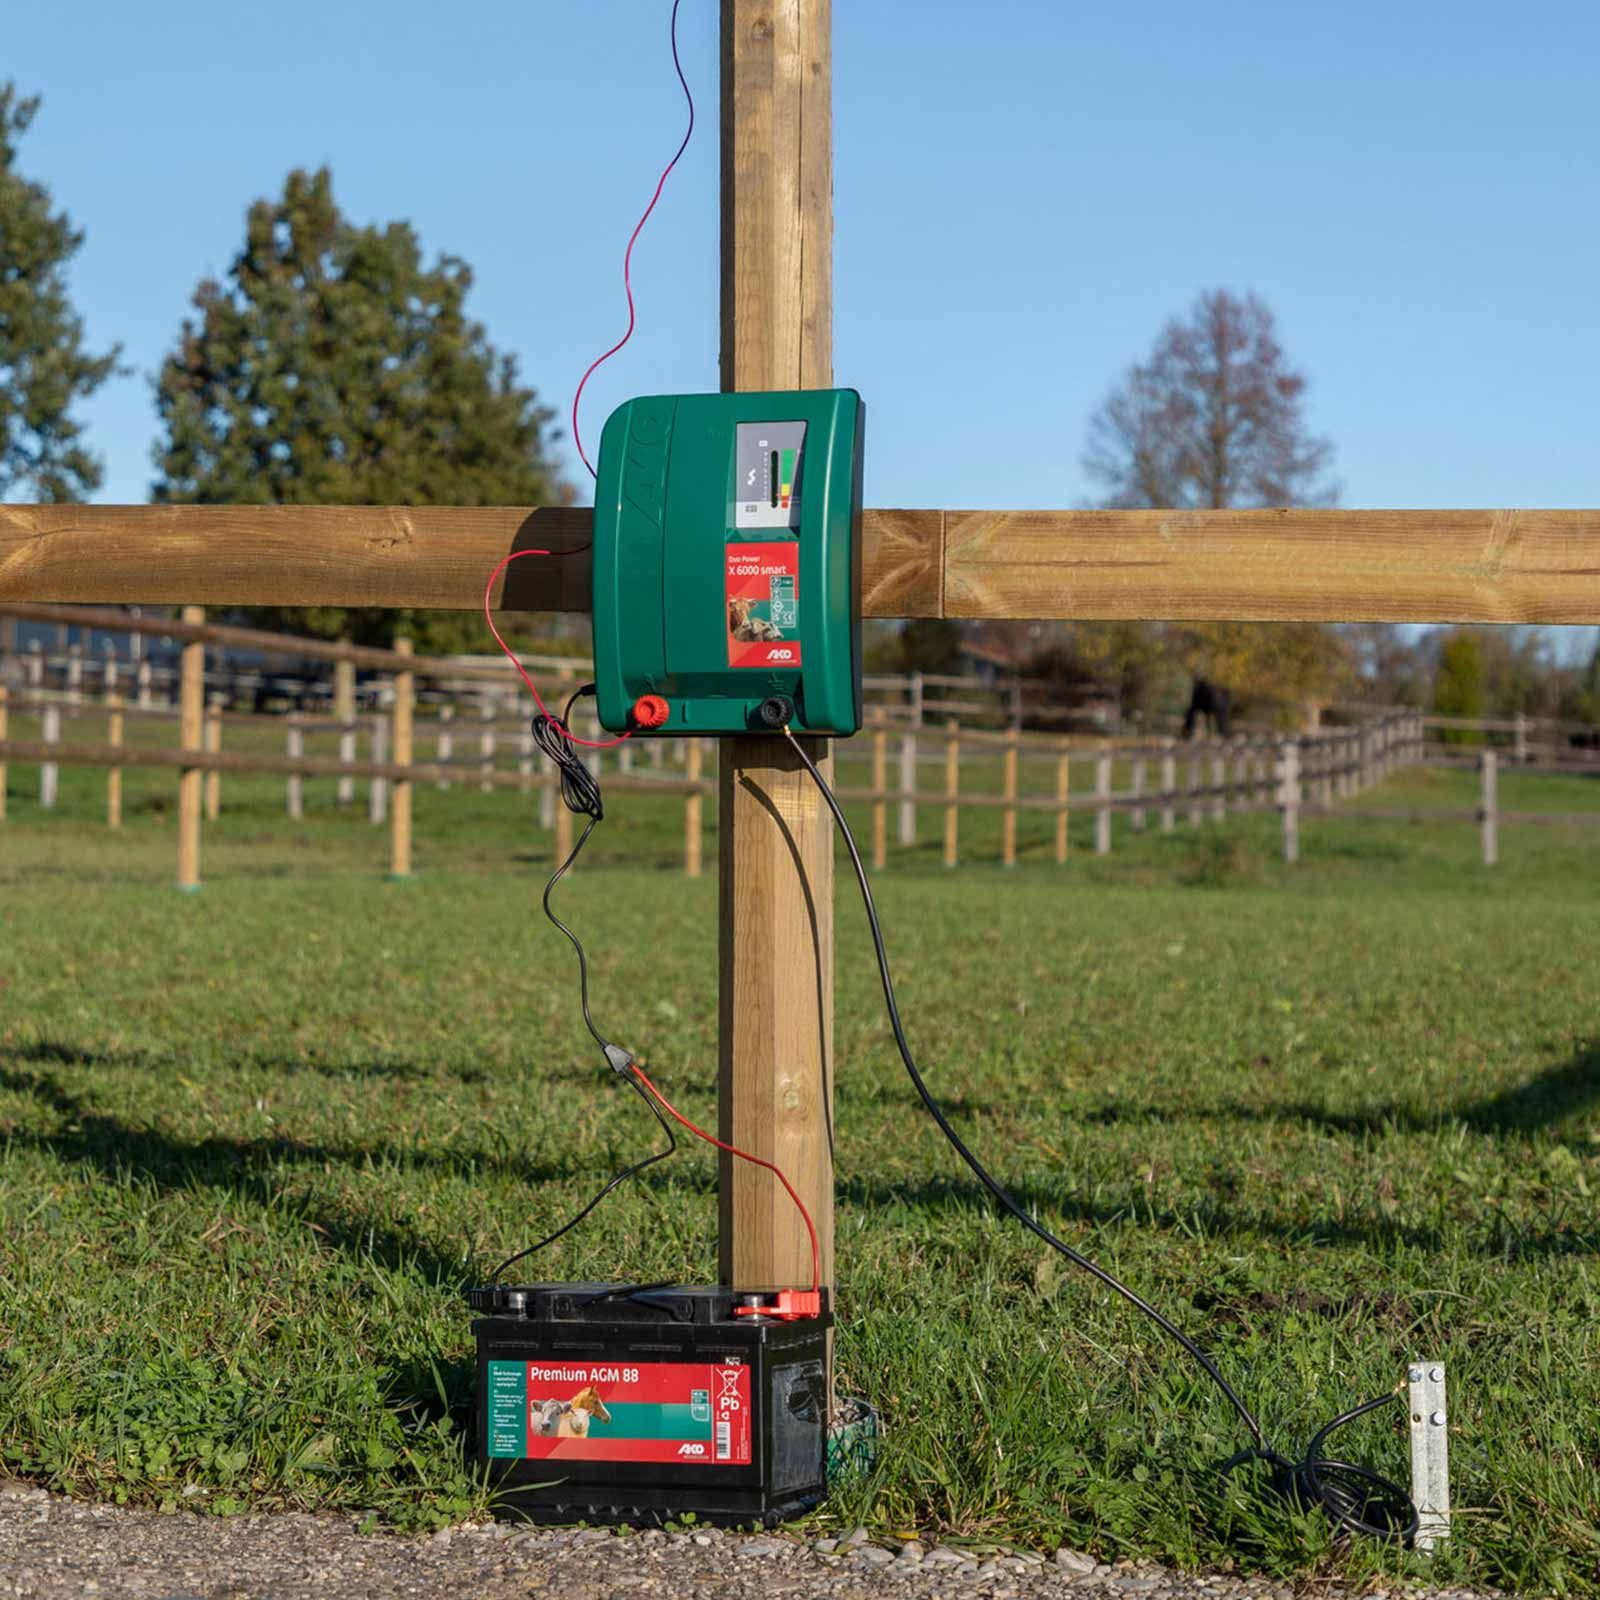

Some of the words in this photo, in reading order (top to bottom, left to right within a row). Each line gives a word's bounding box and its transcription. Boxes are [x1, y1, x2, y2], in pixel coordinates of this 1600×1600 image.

[728, 566, 736, 576] X
[736, 565, 760, 576] 6000
[760, 565, 787, 575] smart
[766, 649, 793, 660] AKO
[530, 1366, 587, 1382] Premium
[589, 1367, 620, 1382] AGM
[622, 1368, 640, 1382] 88
[720, 1396, 740, 1411] Pb
[677, 1443, 705, 1455] AKO
